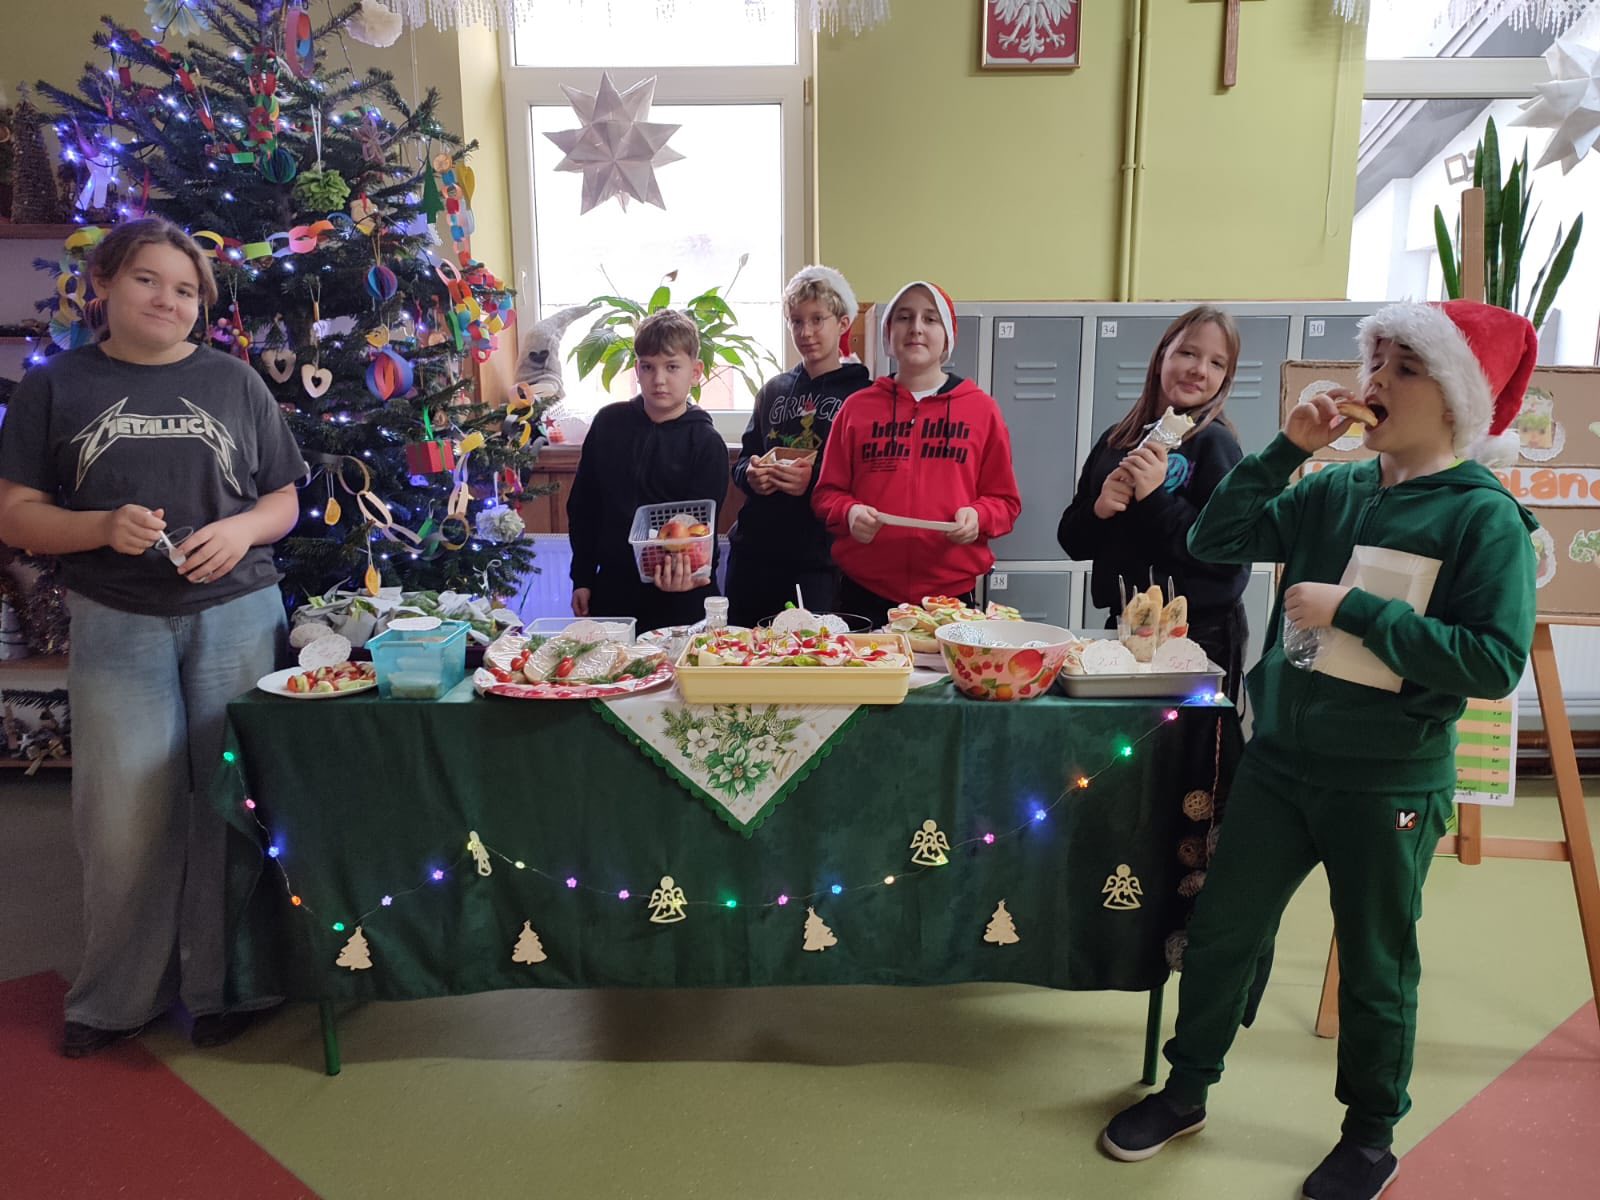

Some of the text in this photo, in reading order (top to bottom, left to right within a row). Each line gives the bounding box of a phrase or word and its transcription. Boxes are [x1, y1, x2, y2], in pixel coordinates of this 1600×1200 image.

[1000, 324, 1014, 336] 37
[1103, 324, 1116, 335] 34
[1310, 323, 1324, 335] 30
[70, 396, 242, 496] METALLICA
[992, 575, 1006, 586] 38
